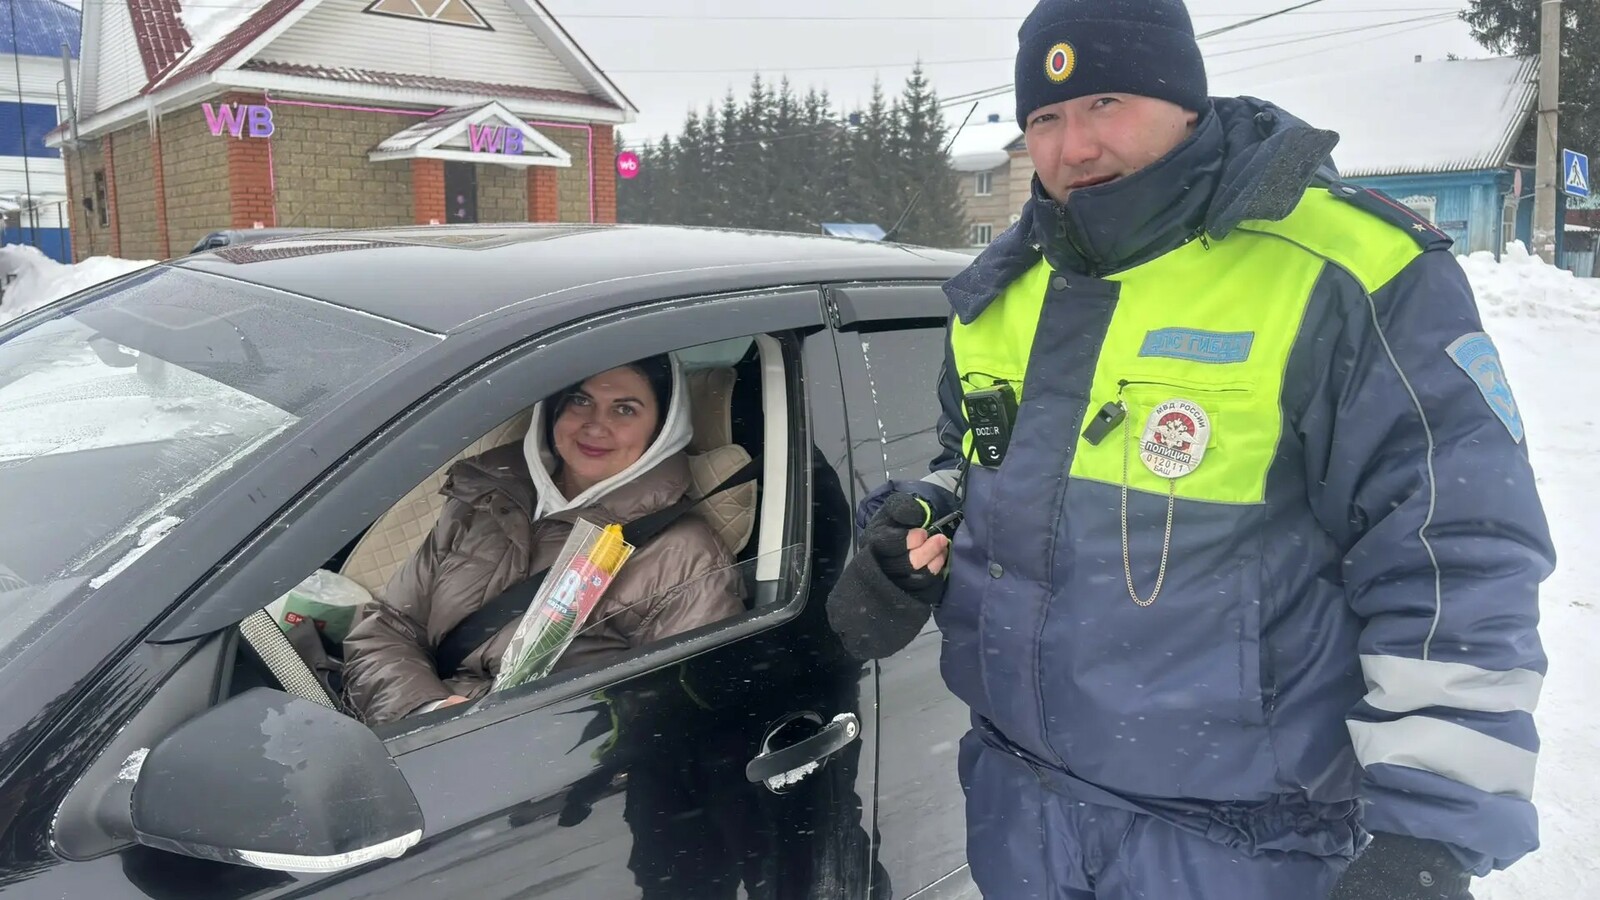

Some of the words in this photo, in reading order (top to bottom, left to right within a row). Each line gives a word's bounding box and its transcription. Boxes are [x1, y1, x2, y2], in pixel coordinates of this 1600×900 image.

[201, 103, 275, 138] WB
[468, 122, 524, 156] WB
[619, 158, 637, 171] wb
[1156, 402, 1176, 415] МВД
[1179, 402, 1206, 429] РОССИИ
[1145, 442, 1191, 463] ПОЛИЦИЯ
[1146, 454, 1184, 473] 012011
[1153, 465, 1171, 476] БАШ
[552, 569, 580, 606] 8
